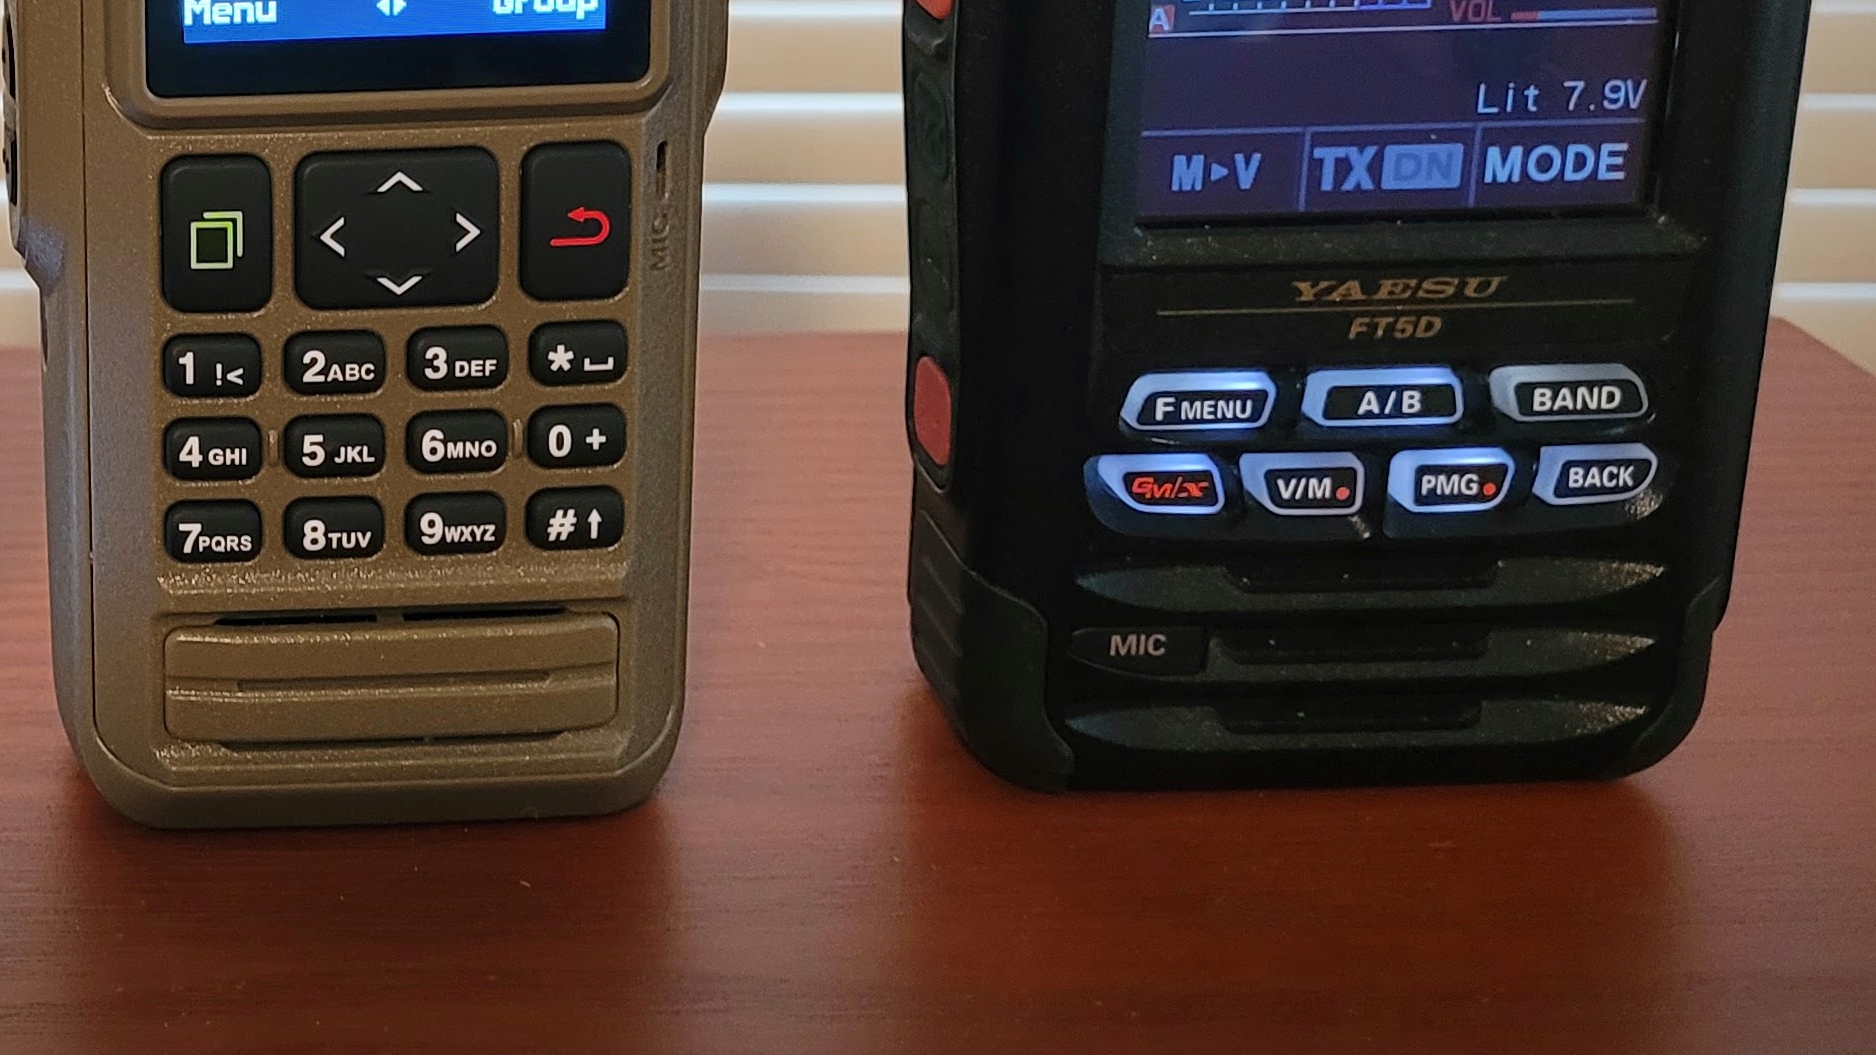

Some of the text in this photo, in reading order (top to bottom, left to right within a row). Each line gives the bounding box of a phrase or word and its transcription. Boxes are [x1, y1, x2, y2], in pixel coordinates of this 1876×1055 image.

[1150, 8, 1172, 31] A
[1562, 78, 1648, 112] 7.9V
[1313, 147, 1454, 192] TX DN
[1483, 141, 1629, 185] MODE
[650, 210, 670, 272] MIC
[1292, 276, 1503, 300] YAESU
[1348, 315, 1442, 341] FT5D
[178, 351, 194, 385] 1
[1154, 397, 1253, 420] F MENU
[1357, 389, 1422, 416] A/B
[1531, 386, 1621, 413] BAND
[548, 424, 572, 458] 0
[334, 445, 376, 464] JKL
[1276, 476, 1332, 500] V/M
[1421, 473, 1480, 497] PMG
[1567, 465, 1634, 489] BACK
[1109, 634, 1167, 657] MIC
